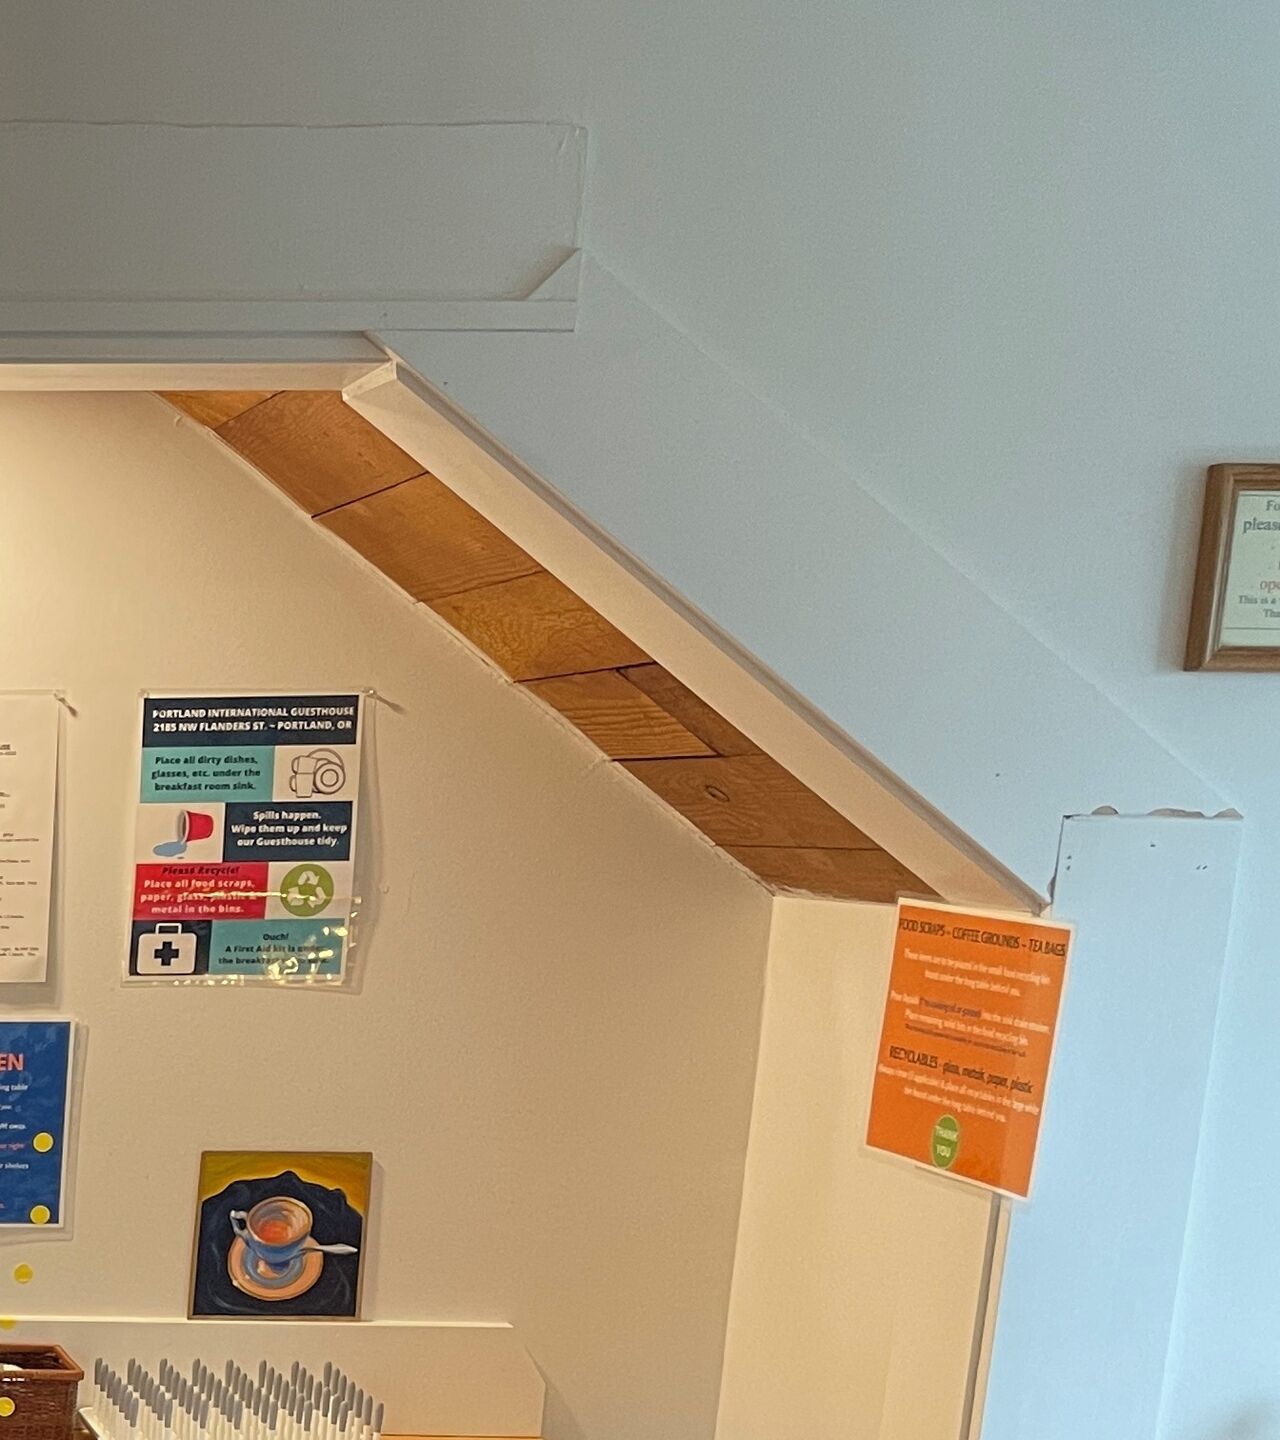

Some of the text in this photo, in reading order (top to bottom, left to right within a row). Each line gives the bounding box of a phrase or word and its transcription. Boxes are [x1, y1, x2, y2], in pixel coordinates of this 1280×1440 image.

[152, 706, 355, 718] PORTLAND INTERNATIONAL GUESTHOUSE
[152, 720, 352, 732] 2185 NW FLANDERS ST. PORTLAND, OR
[155, 755, 258, 766] Place all dirty dishes,
[151, 769, 189, 780] glasses,
[212, 769, 242, 777] under
[244, 769, 261, 777] the
[154, 782, 257, 791] breakfast room sink.
[252, 811, 322, 821] Spills happen.
[231, 823, 348, 834] Wipe them up and keep
[255, 837, 315, 846] Guesthouse
[143, 879, 173, 888] Place
[174, 879, 190, 888] all
[191, 879, 215, 888] food
[151, 905, 182, 913] metal
[184, 905, 196, 913] in
[198, 905, 217, 913] the
[952, 927, 981, 943] COFFEE
[981, 930, 1020, 949] GROUNDS
